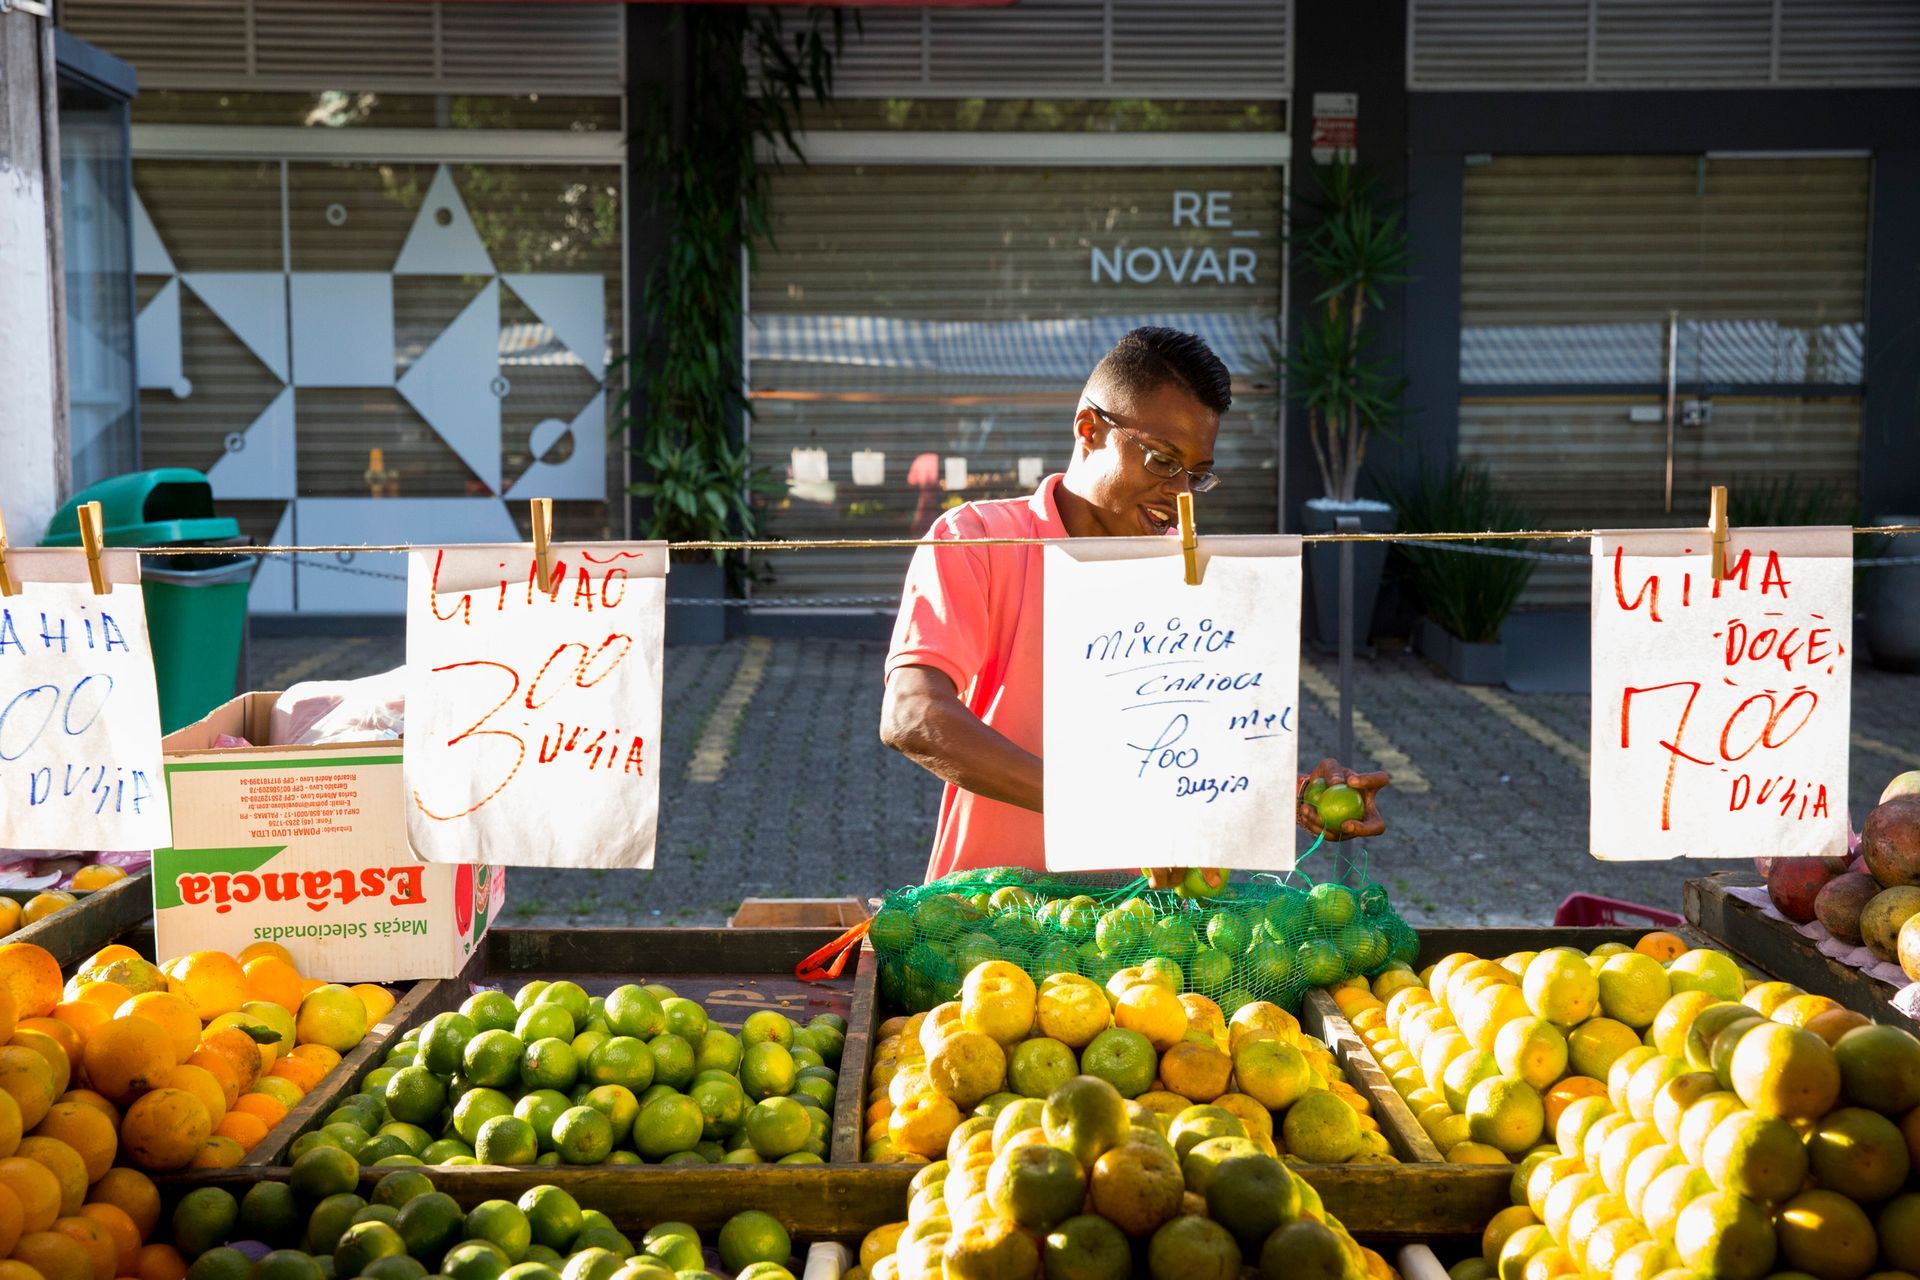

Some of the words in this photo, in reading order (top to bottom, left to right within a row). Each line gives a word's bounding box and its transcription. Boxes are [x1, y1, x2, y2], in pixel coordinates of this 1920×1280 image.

[1091, 247, 1257, 284] NOVAR
[248, 829, 270, 838] LTDA.
[272, 829, 291, 837] LOVO
[294, 828, 320, 836] POMAR
[178, 866, 427, 914] Estância
[254, 922, 367, 941] Selecionadas
[375, 919, 428, 936] Maçãs
